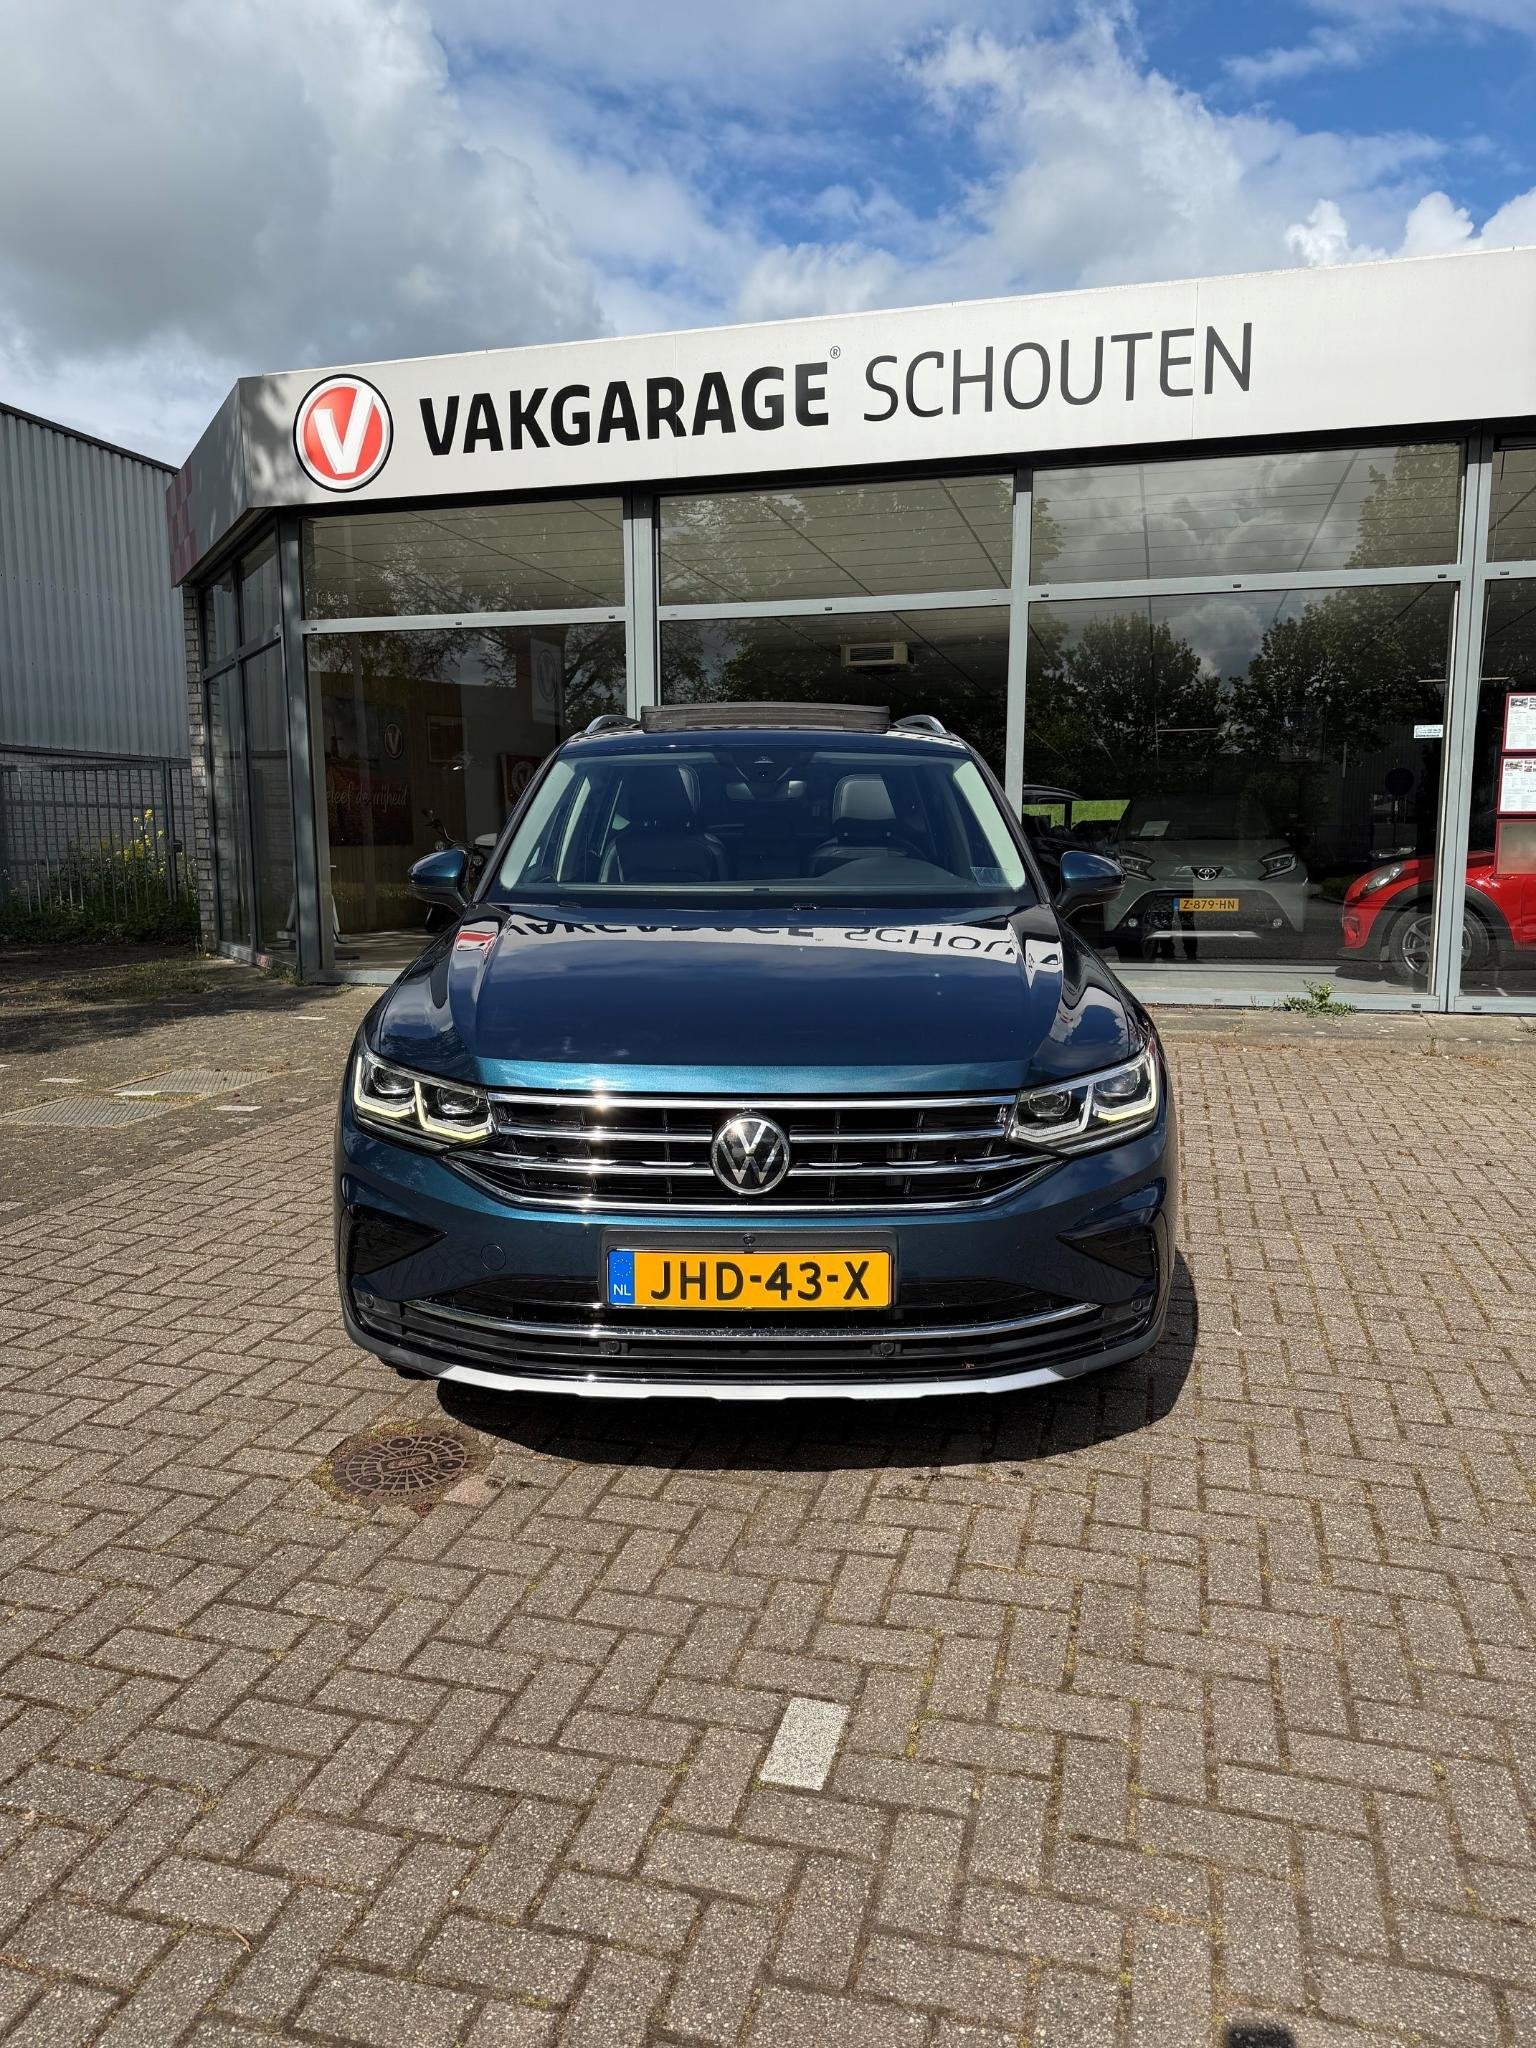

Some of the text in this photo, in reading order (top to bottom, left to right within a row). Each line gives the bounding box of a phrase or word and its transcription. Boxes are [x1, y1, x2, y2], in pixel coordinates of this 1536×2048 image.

[863, 321, 1253, 422] SCHOUTEN
[312, 384, 380, 476] V
[1183, 900, 1235, 910] Z-879-HN
[613, 1260, 870, 1302] NL JHD-43-X
